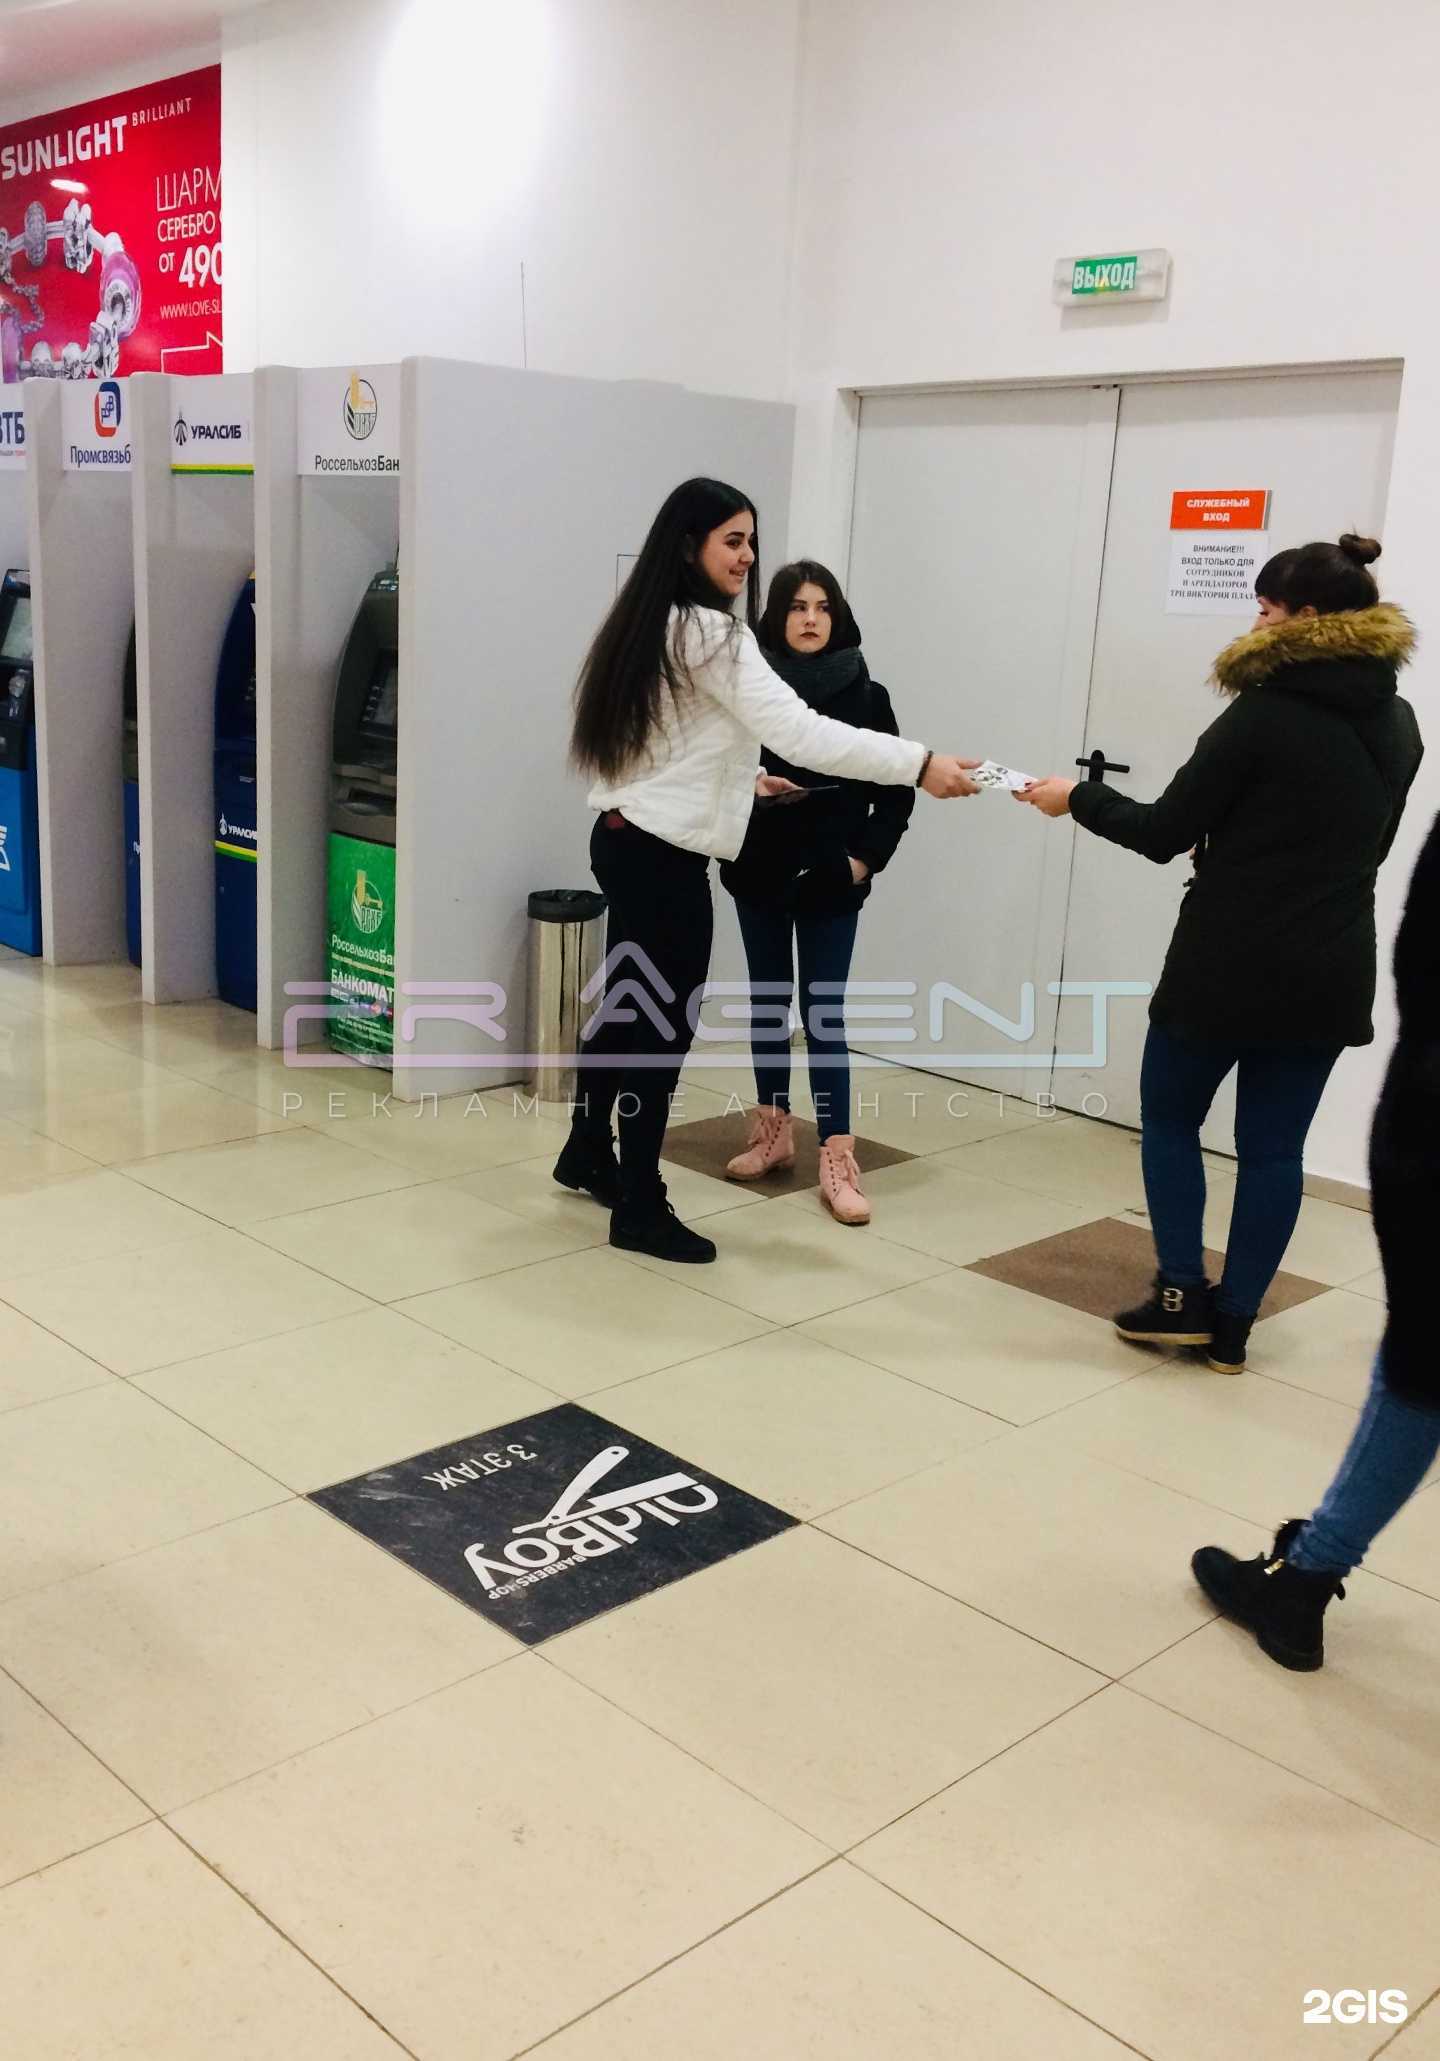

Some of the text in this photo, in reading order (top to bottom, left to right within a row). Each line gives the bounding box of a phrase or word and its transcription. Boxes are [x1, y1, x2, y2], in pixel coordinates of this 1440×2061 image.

[1, 97, 192, 181] SUNLIGHT BRILLIANT
[157, 210, 216, 243] СЕРЕБРО
[158, 242, 222, 289] ОТ 490
[1073, 261, 1136, 290] ВЫХОД
[0, 411, 25, 444] ТБ
[190, 424, 242, 440] УРАЛСИБ
[70, 443, 131, 468] Промсвязьб
[315, 454, 400, 472] РоссельхозБан
[1186, 497, 1251, 509] СЛУЖЕБНЫЙ
[1203, 512, 1231, 522] ВХОД
[1181, 557, 1254, 568] ВХОД ТОЛЬКО ДЛЯ
[1193, 544, 1245, 554] ВНИМАНИЕ!!!
[1186, 568, 1245, 578] СОТРУДНИКОВ
[331, 968, 395, 1004] БАНКОМАТ
[422, 1444, 538, 1491] 3 ЭТАЖ
[487, 1555, 588, 1600] BARBERSHOP
